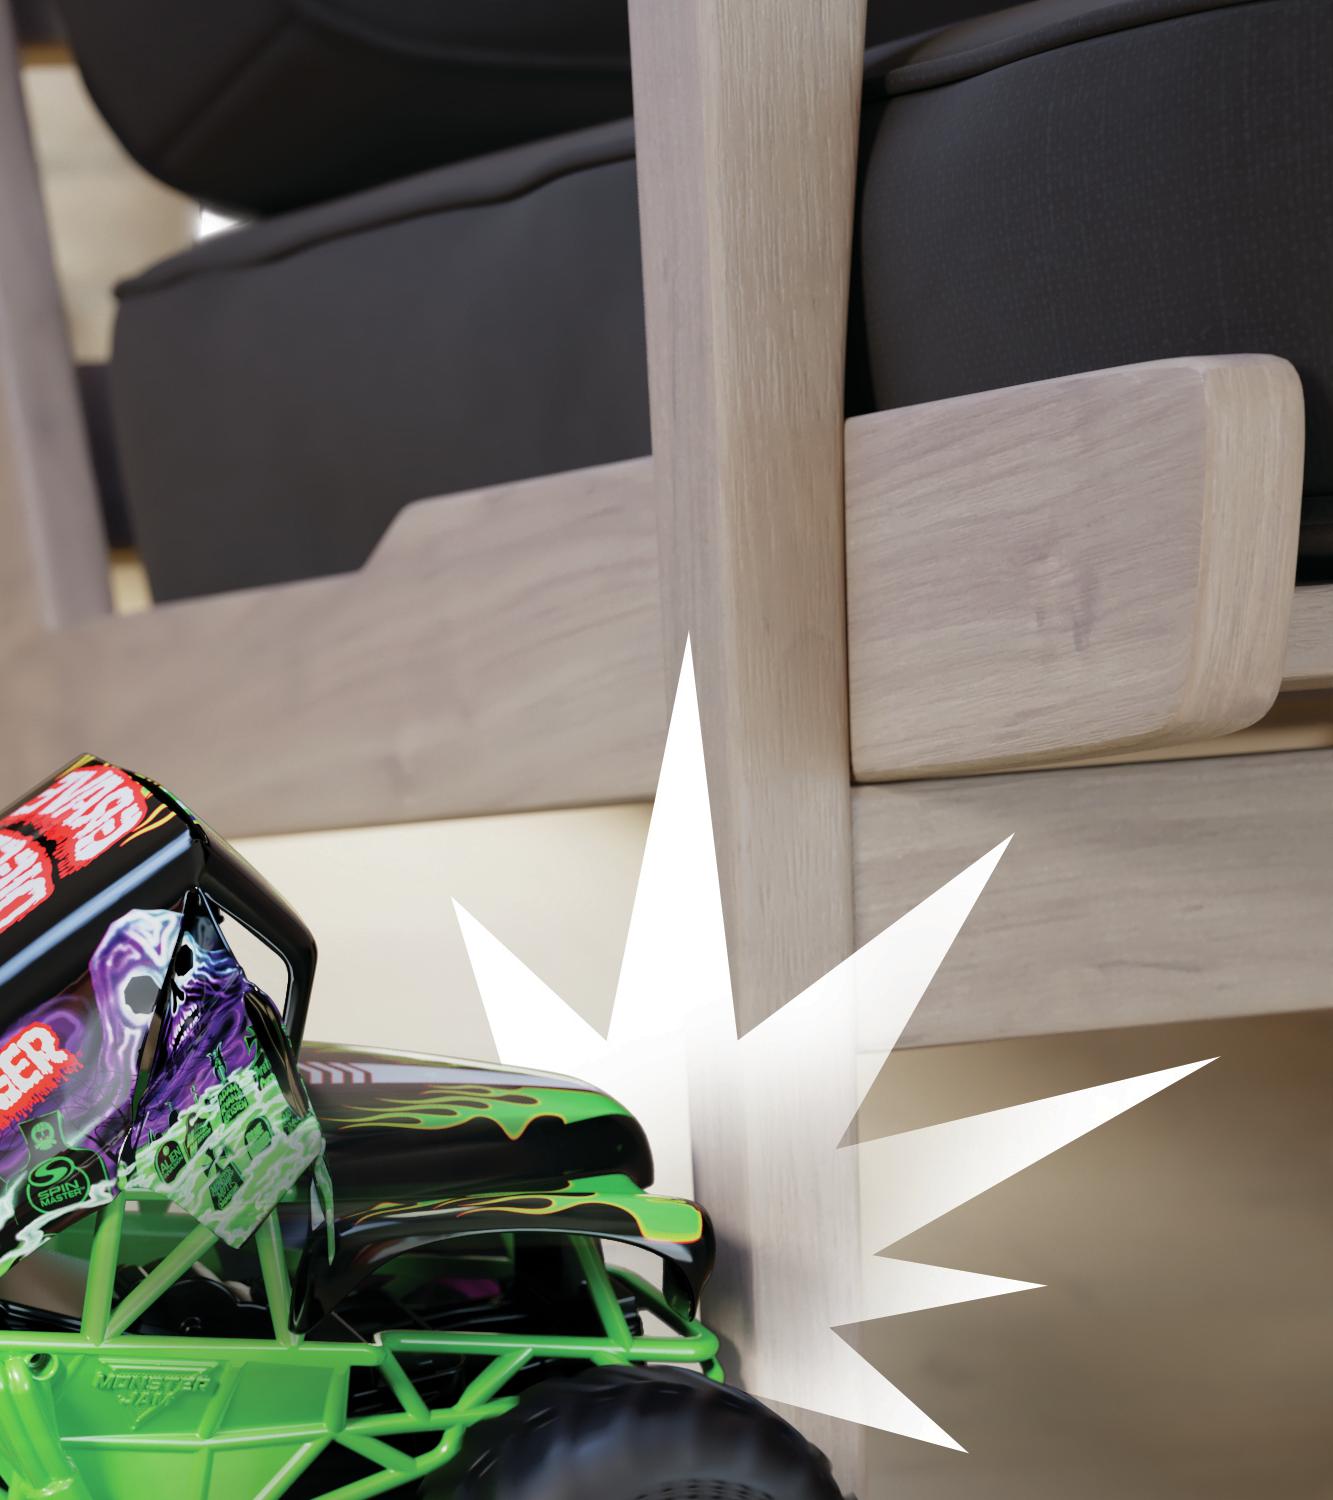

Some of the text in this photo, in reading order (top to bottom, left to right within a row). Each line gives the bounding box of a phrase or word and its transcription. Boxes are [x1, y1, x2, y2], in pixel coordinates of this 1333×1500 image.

[160, 1145, 182, 1173] ALIEN
[38, 1179, 80, 1200] SPIN
[93, 1371, 211, 1391] MONSTER
[118, 1390, 174, 1406] JAM
